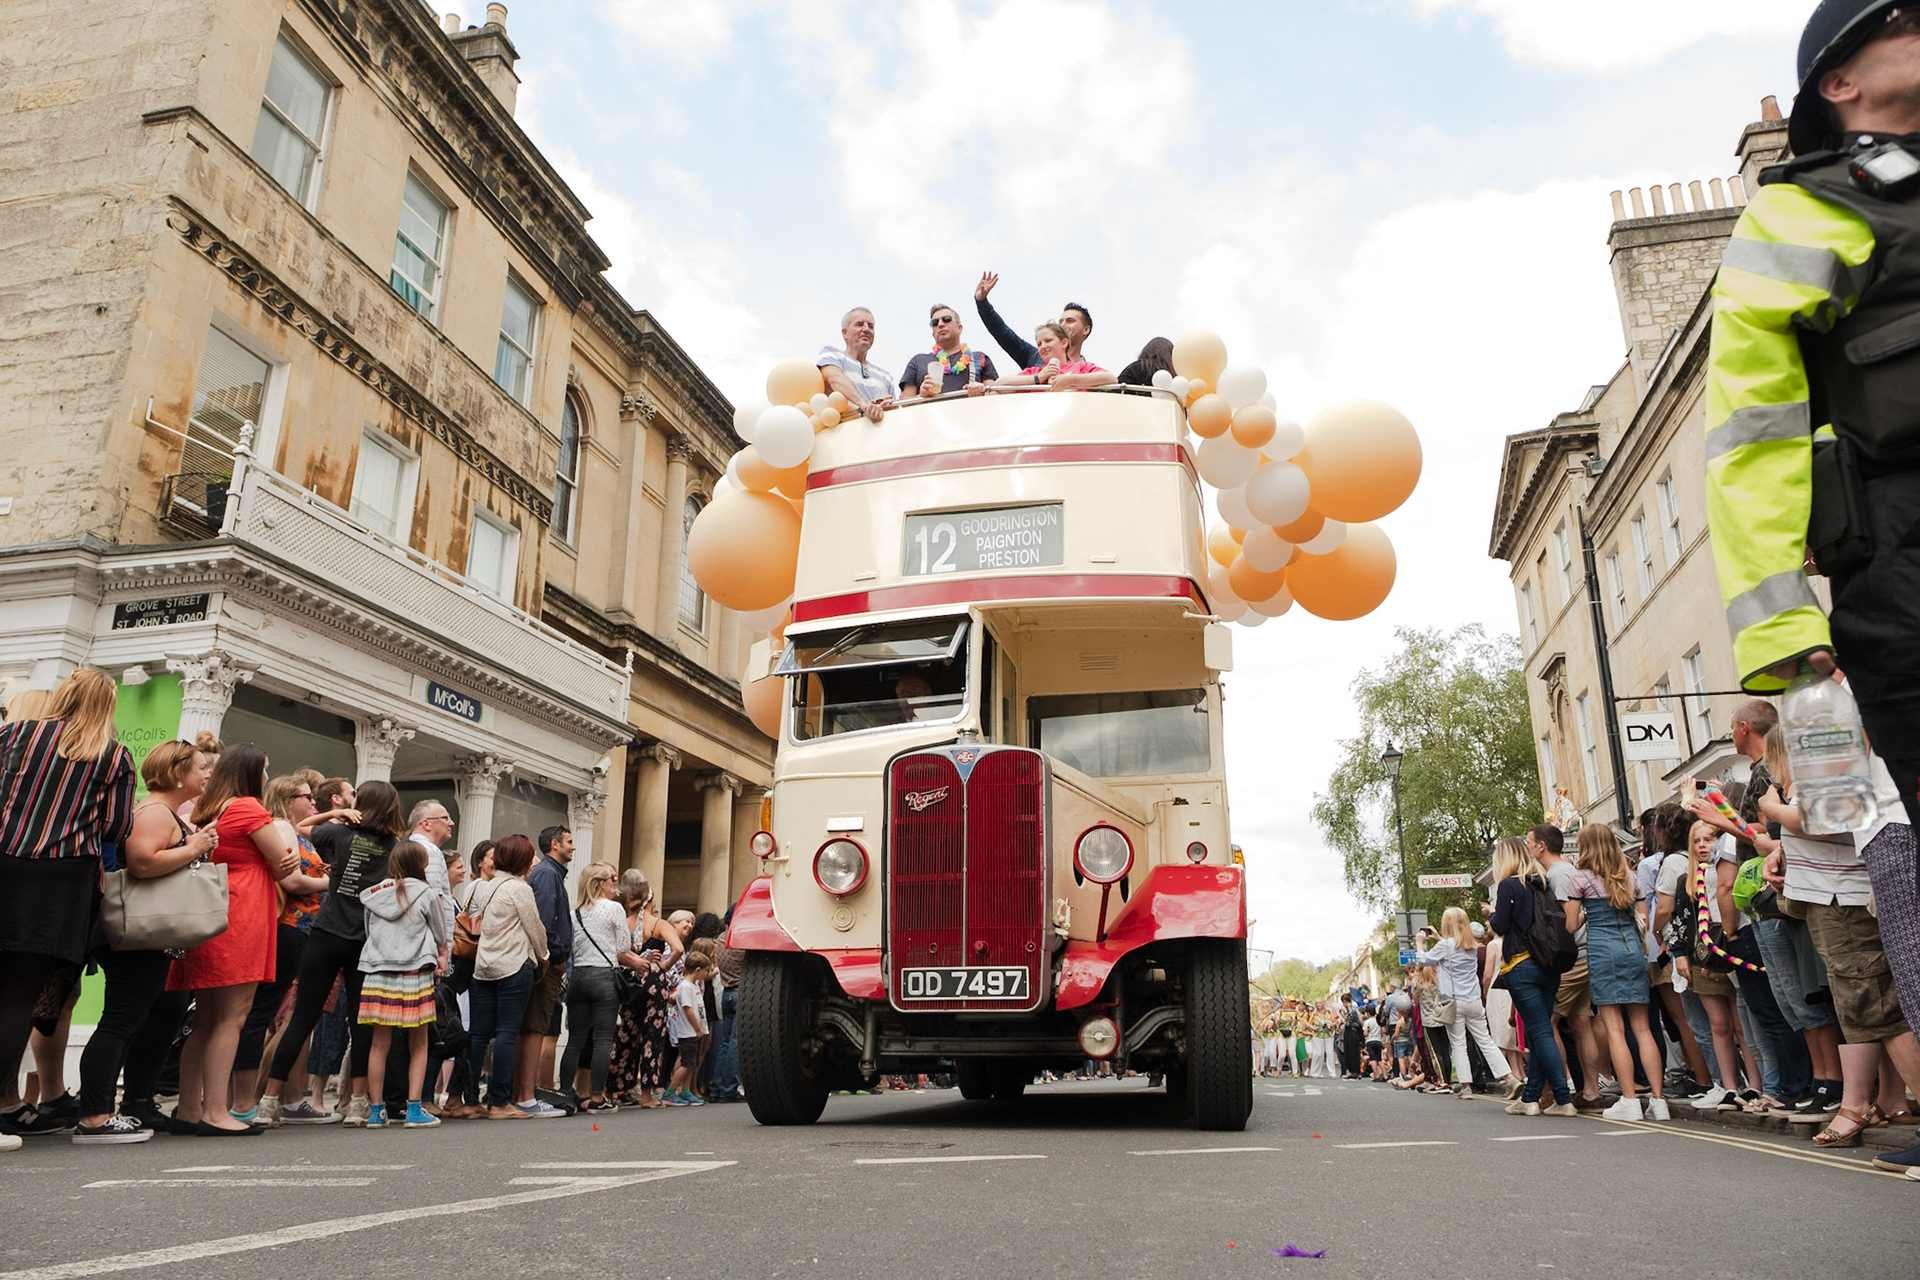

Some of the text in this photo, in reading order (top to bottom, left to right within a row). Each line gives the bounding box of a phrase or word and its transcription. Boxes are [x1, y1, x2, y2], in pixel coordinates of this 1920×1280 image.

[960, 510, 1057, 536] GOODRINGTON
[915, 521, 957, 575] 12
[976, 529, 1042, 551] PAIGNTON
[979, 548, 1040, 568] PRESTON
[125, 595, 202, 613] GROVE STREET
[116, 620, 129, 629] ST
[176, 611, 204, 624] ROAD
[434, 687, 475, 718] McColl's
[1626, 723, 1674, 742] DM
[955, 751, 975, 764] AEC
[905, 786, 949, 811] Regent
[1421, 876, 1462, 886] CHEMIST
[907, 970, 1022, 996] OD 7497
